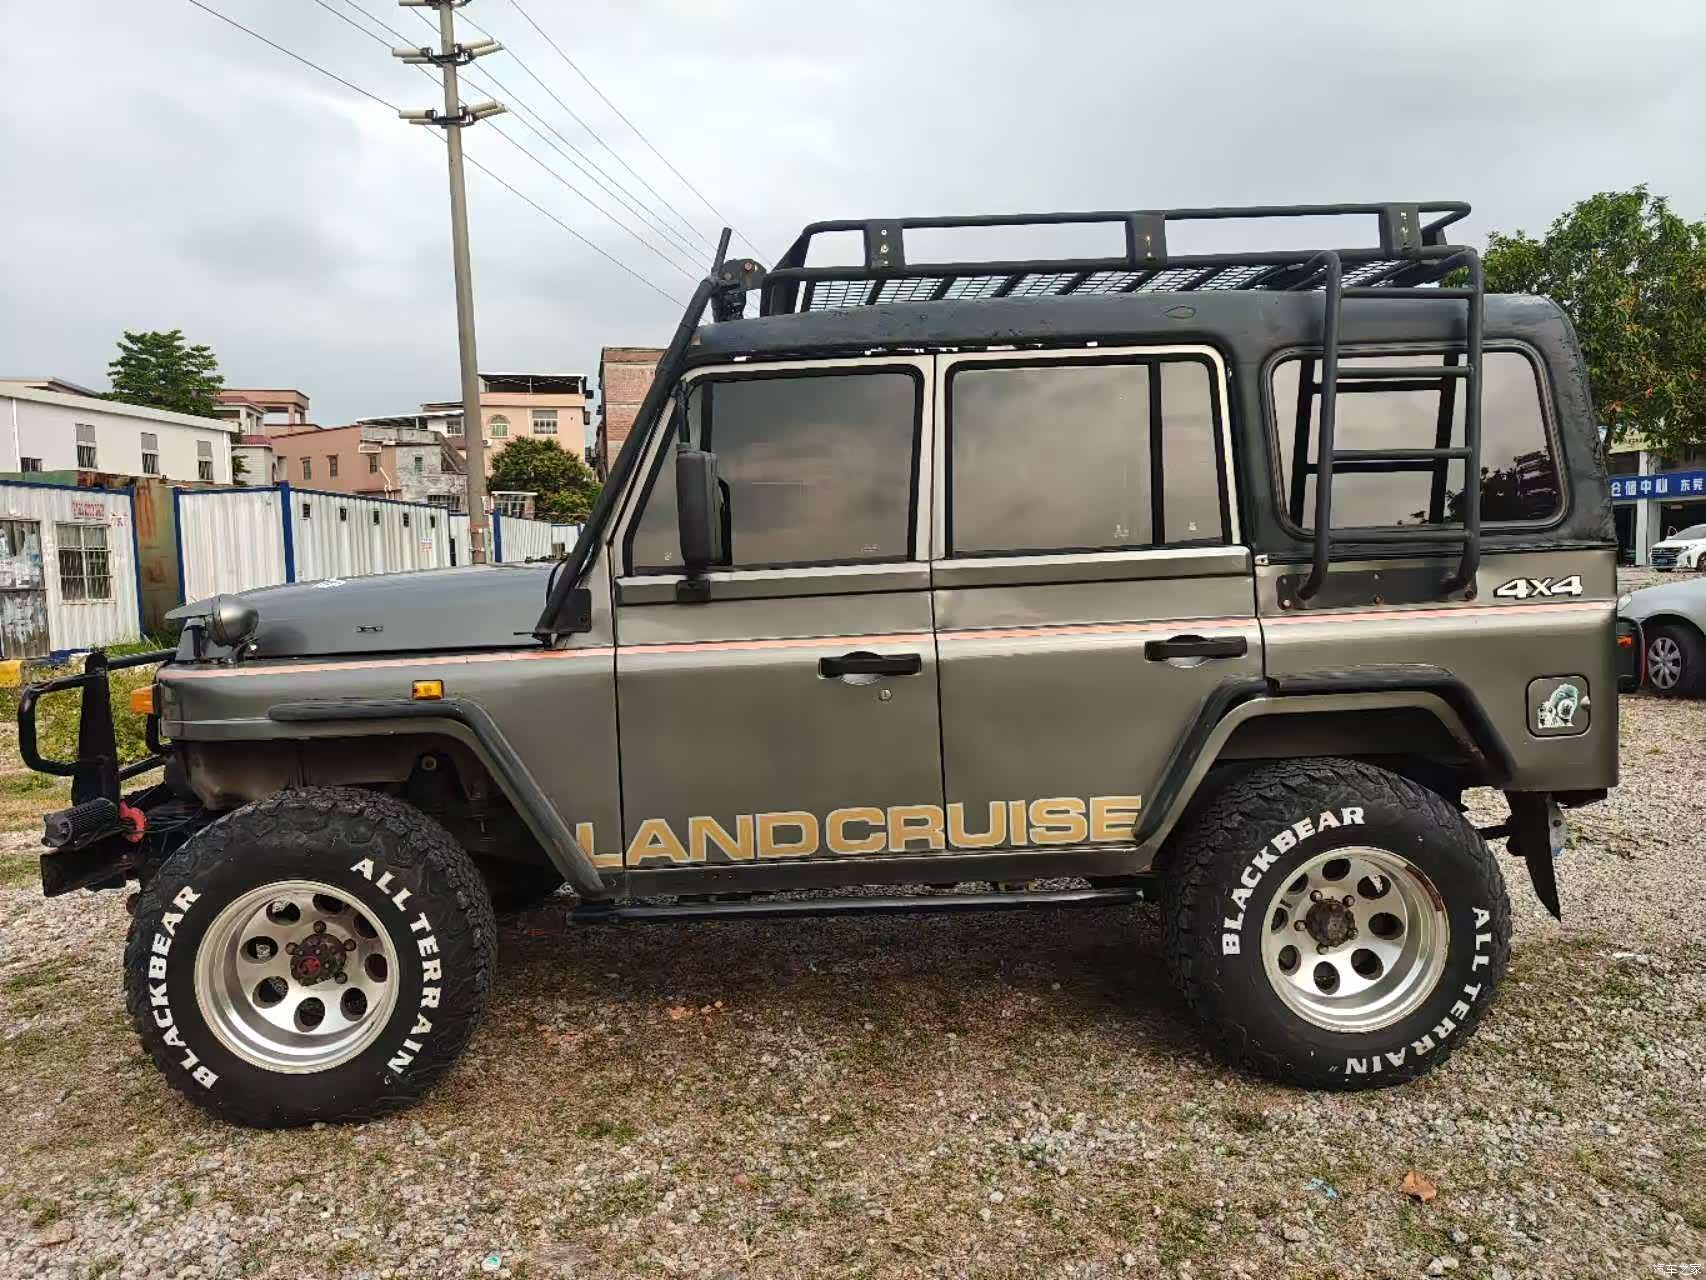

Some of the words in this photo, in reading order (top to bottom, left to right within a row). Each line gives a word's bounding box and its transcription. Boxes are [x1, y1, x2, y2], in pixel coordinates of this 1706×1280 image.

[1221, 806, 1366, 956] BLACKBEAR
[1471, 906, 1492, 972] ALL
[148, 885, 219, 1090] BLACKBEAR
[350, 857, 412, 912] ALL
[386, 912, 442, 1075] TERRAIN
[1344, 982, 1482, 1075] TERRAIN
